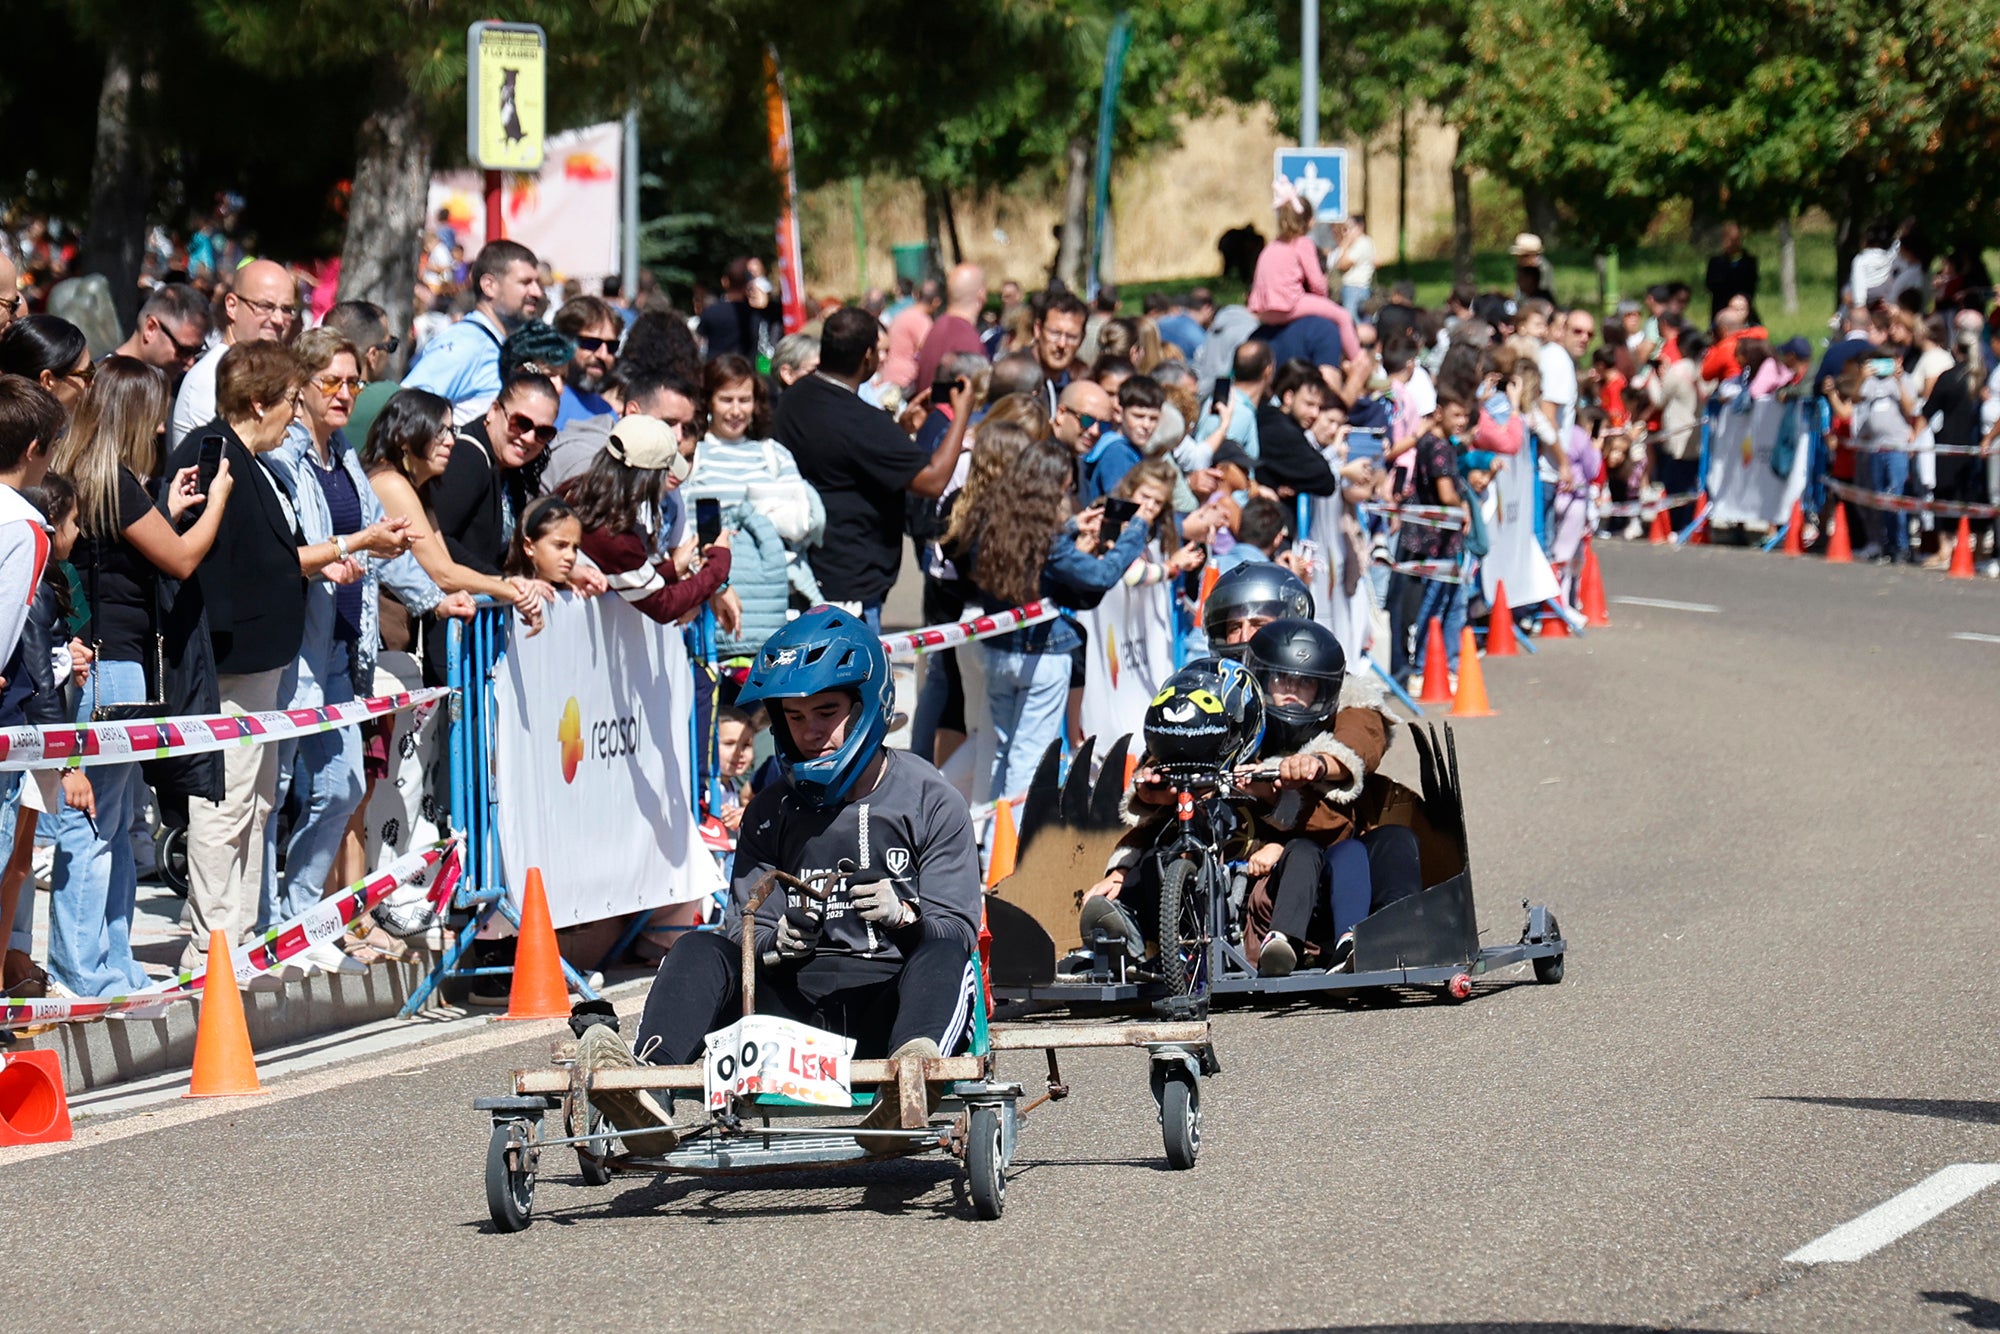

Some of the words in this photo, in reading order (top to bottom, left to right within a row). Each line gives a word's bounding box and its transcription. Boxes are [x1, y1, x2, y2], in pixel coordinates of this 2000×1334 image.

[591, 705, 642, 769] repsol
[825, 910, 843, 920] 2025
[717, 1040, 780, 1082] 002
